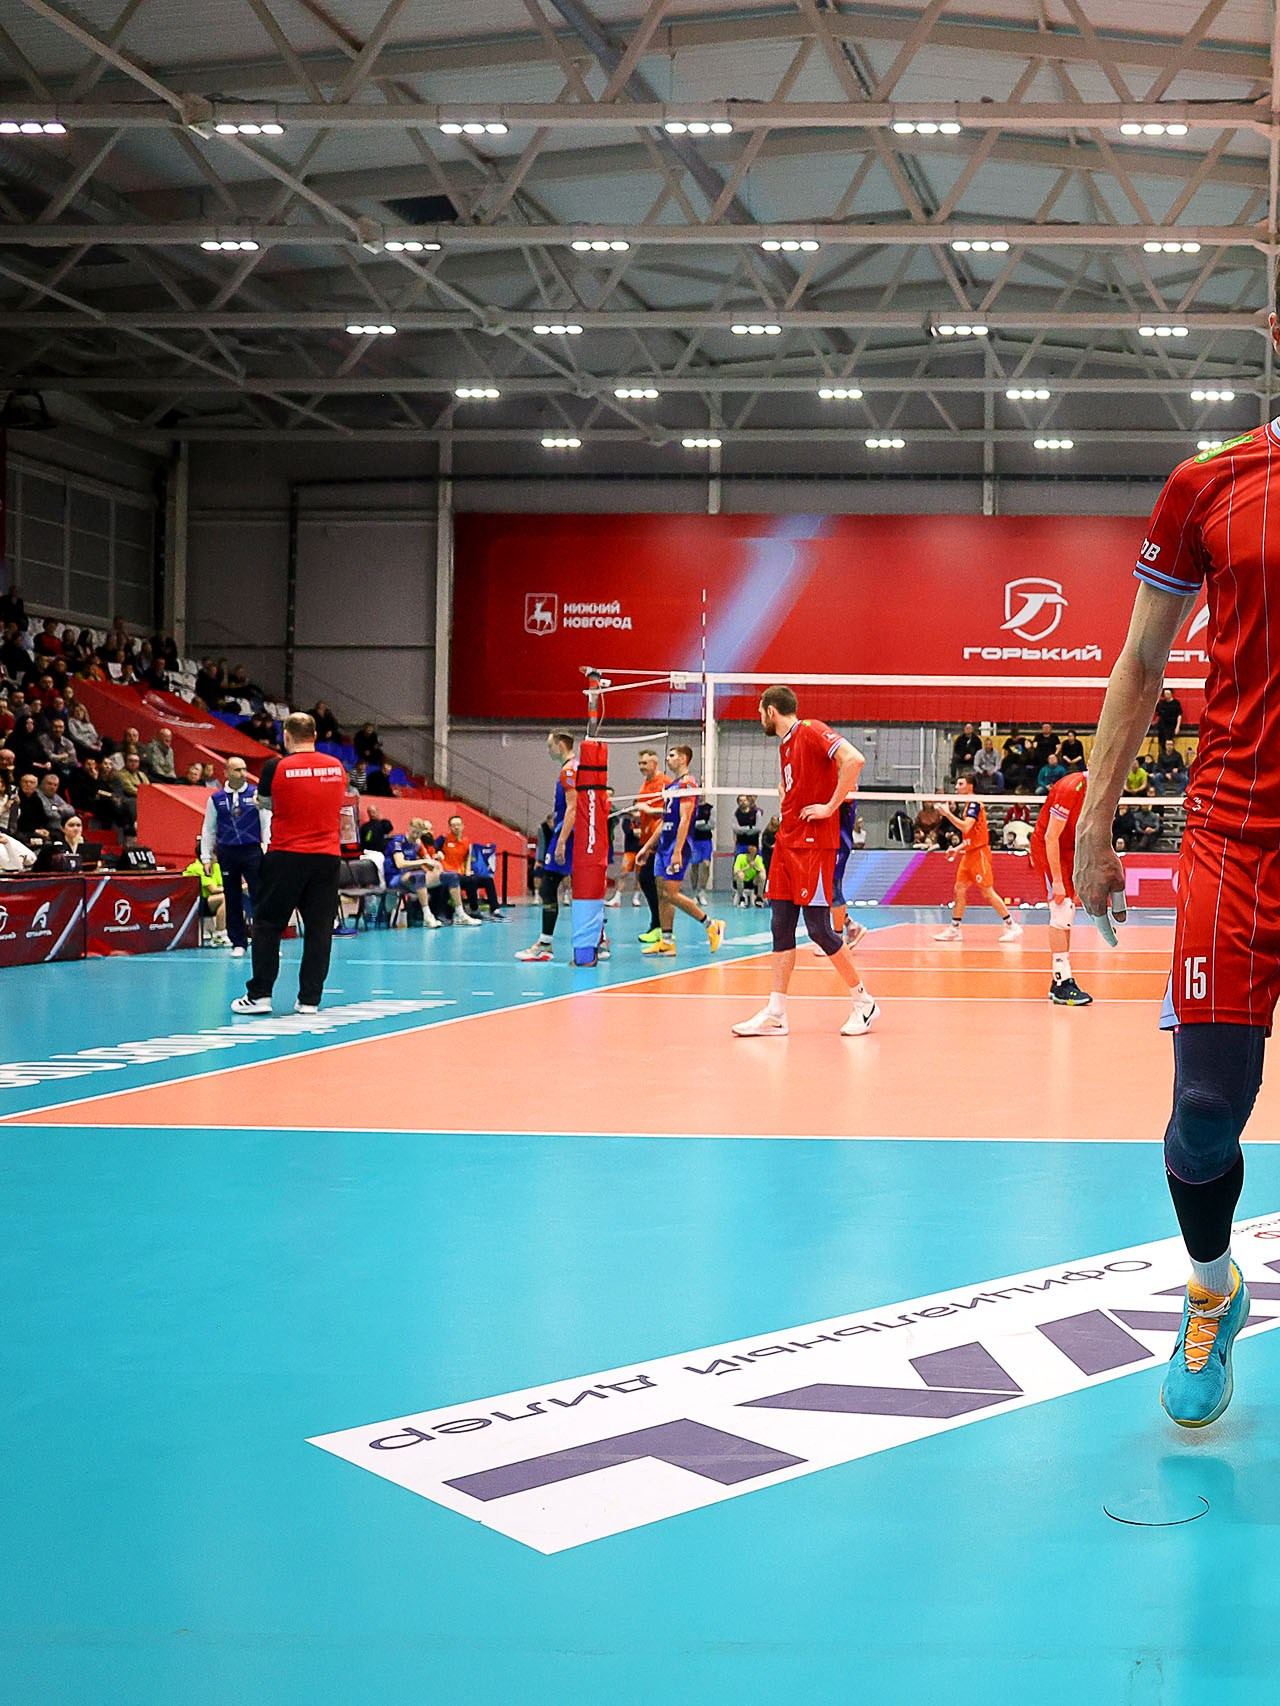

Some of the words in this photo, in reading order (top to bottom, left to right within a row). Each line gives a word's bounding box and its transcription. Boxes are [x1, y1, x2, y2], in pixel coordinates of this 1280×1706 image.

[563, 600, 620, 614] НИЖНИЙ
[563, 616, 632, 630] НОВГОРОД
[963, 645, 1102, 661] ГОРЬКИЙ
[1184, 956, 1207, 1000] 15
[683, 1259, 1155, 1376] Официальный
[367, 1372, 661, 1453] дилер
